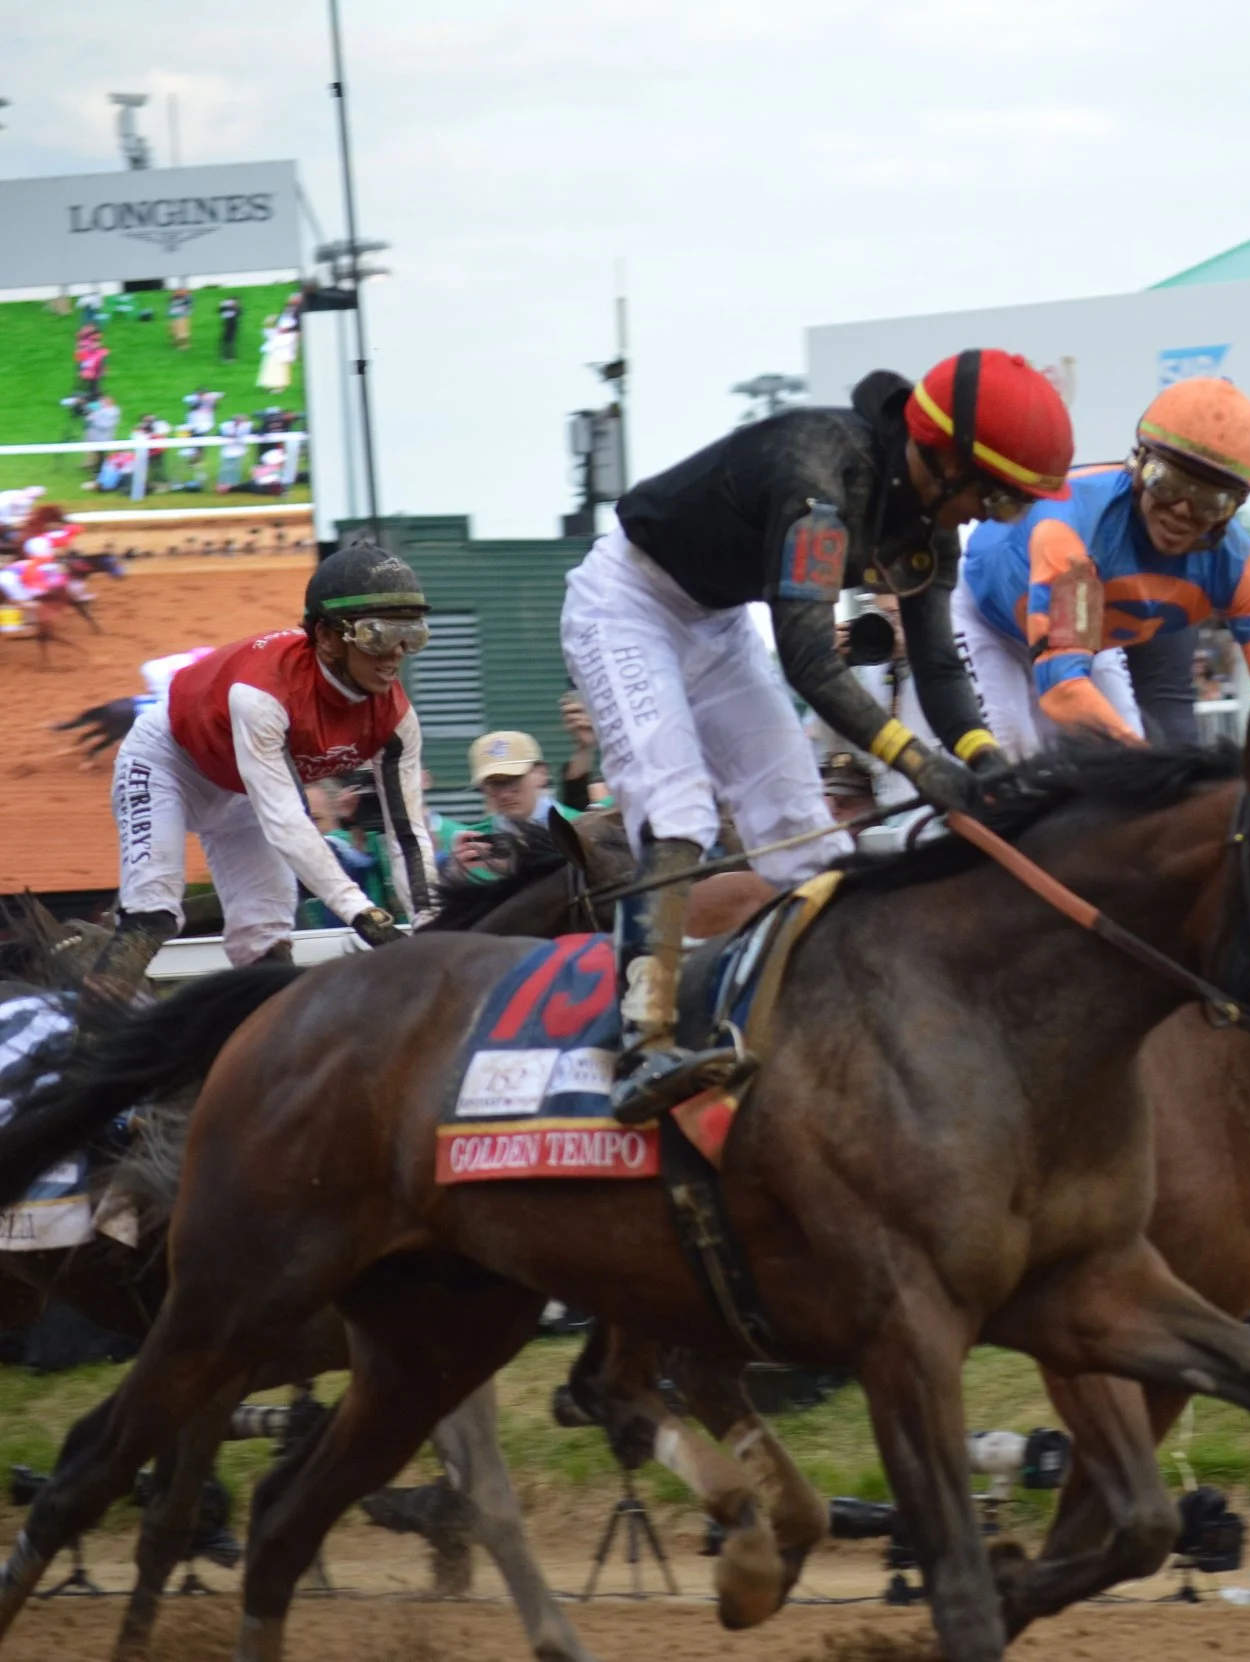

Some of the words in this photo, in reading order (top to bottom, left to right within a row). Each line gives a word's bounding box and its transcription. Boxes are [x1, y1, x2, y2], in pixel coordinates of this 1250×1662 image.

[67, 193, 273, 234] LONGINES
[792, 527, 846, 586] 19
[578, 622, 636, 770] WHISPERER
[611, 645, 660, 728] HORSE
[450, 1134, 539, 1174] GOLDEN
[546, 1130, 647, 1170] TEMPO
